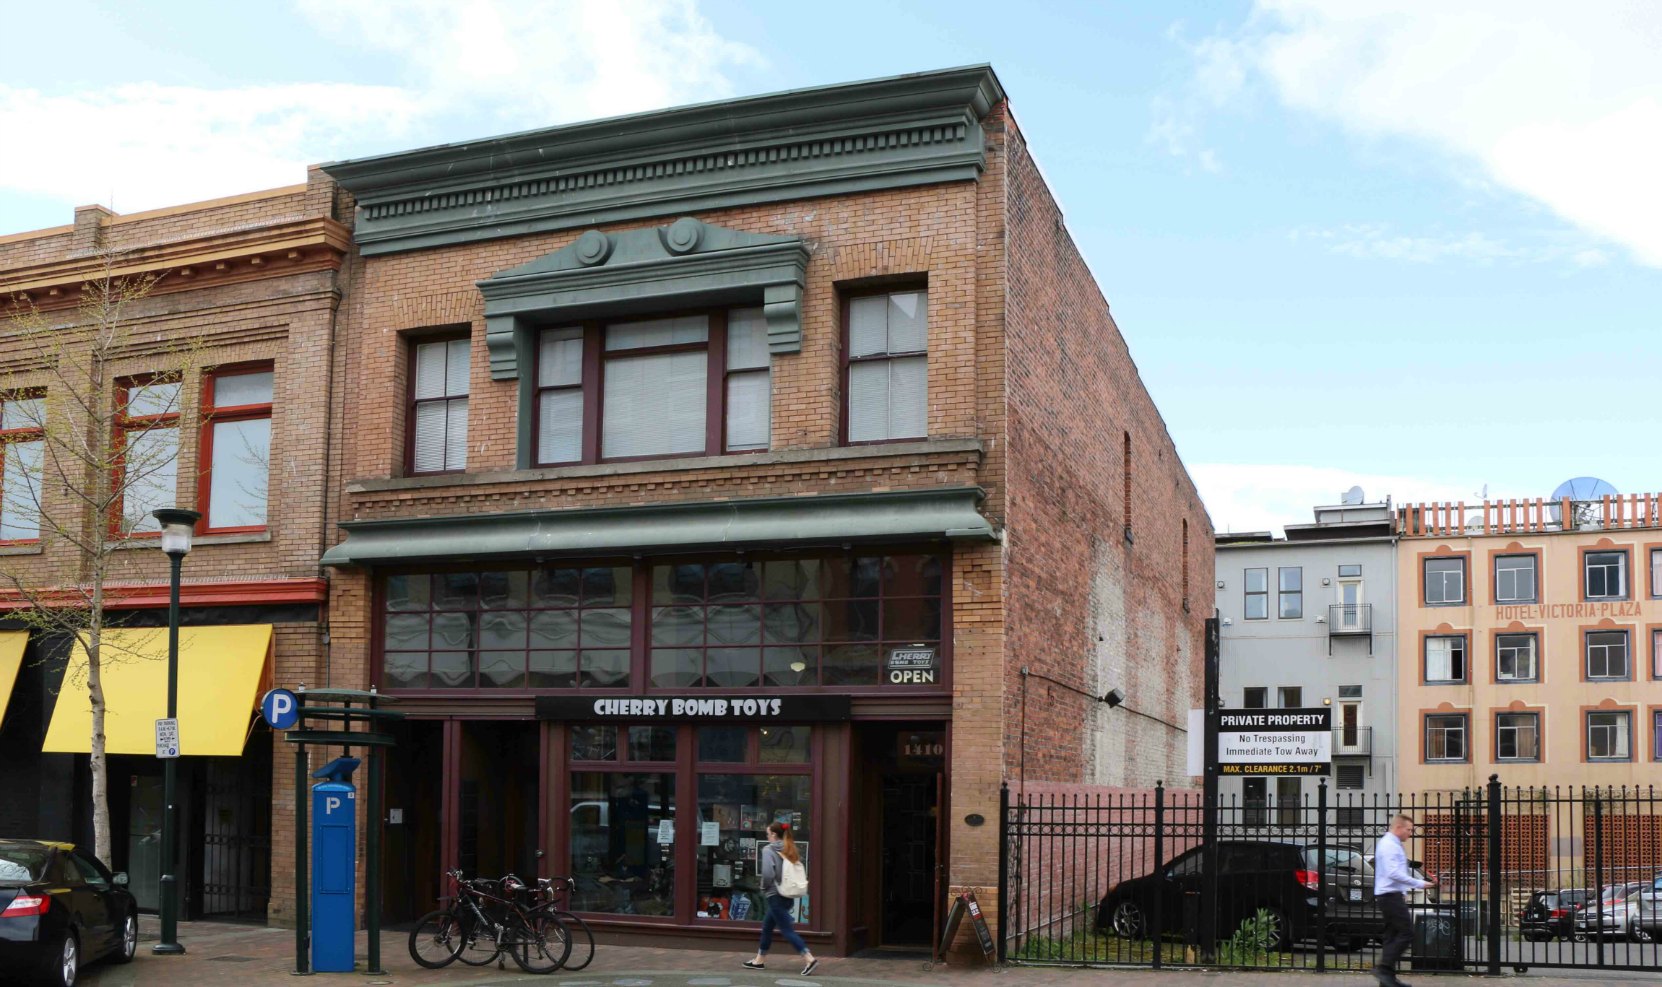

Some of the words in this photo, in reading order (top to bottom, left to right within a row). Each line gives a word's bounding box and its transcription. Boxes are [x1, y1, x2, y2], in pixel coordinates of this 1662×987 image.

[892, 650, 933, 660] CHERRY
[890, 670, 934, 683] OPEN
[271, 693, 292, 724] P
[593, 699, 669, 716] CHERRY
[671, 698, 728, 716] BOMB
[731, 698, 782, 716] TOYS
[1220, 715, 1265, 726] PRIVATE
[1267, 714, 1324, 726] PROPERTY
[1239, 734, 1251, 743] No
[1253, 733, 1306, 744] Trespassing
[904, 743, 944, 756] 1410
[1226, 747, 1272, 756] Immediate
[1275, 747, 1292, 756] Tow
[1295, 747, 1319, 757] Away
[1223, 765, 1242, 773] MAX.
[1244, 765, 1287, 773] CLEARANCE
[1289, 765, 1308, 773] 2.1m
[326, 797, 341, 815] P
